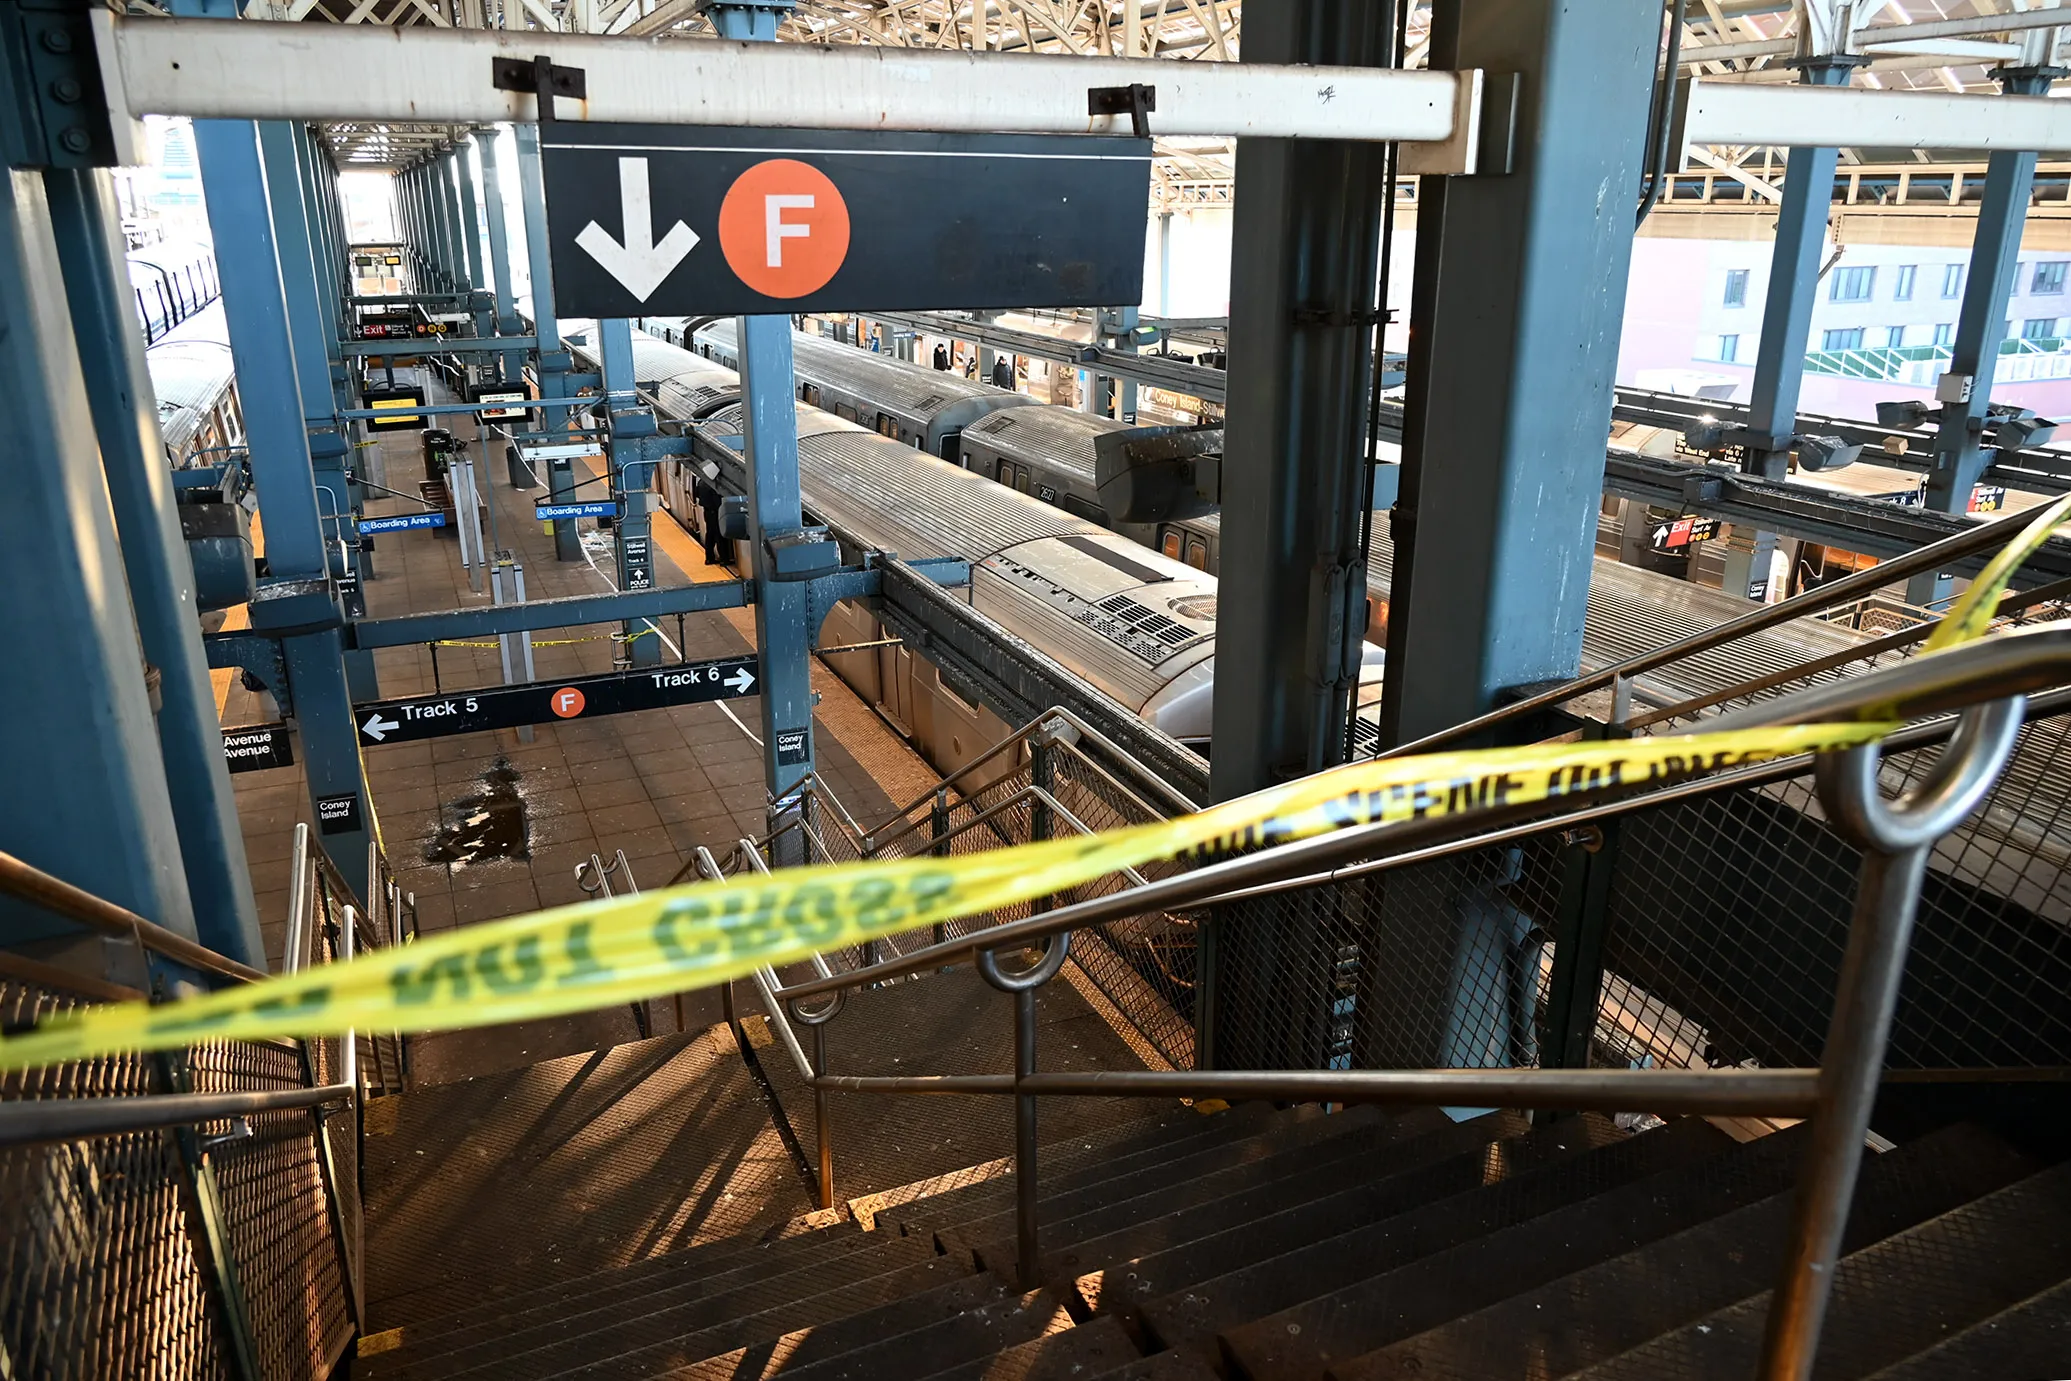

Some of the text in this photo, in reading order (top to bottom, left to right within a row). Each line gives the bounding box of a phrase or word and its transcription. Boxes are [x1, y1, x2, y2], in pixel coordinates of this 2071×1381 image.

[764, 194, 815, 268] F
[363, 325, 383, 335] Exit
[1155, 390, 1177, 408] Coney
[1698, 449, 1709, 457] End
[547, 507, 582, 516] Boarding
[371, 517, 430, 529] Boarding Area
[1671, 522, 1690, 533] Exit
[401, 667, 720, 721] Track 5 F Track 6
[224, 733, 272, 748] Avenue
[778, 735, 804, 746] Coney
[224, 745, 271, 759] Avenue
[778, 743, 802, 753] Island
[320, 801, 351, 811] Coney
[321, 809, 349, 820] Island
